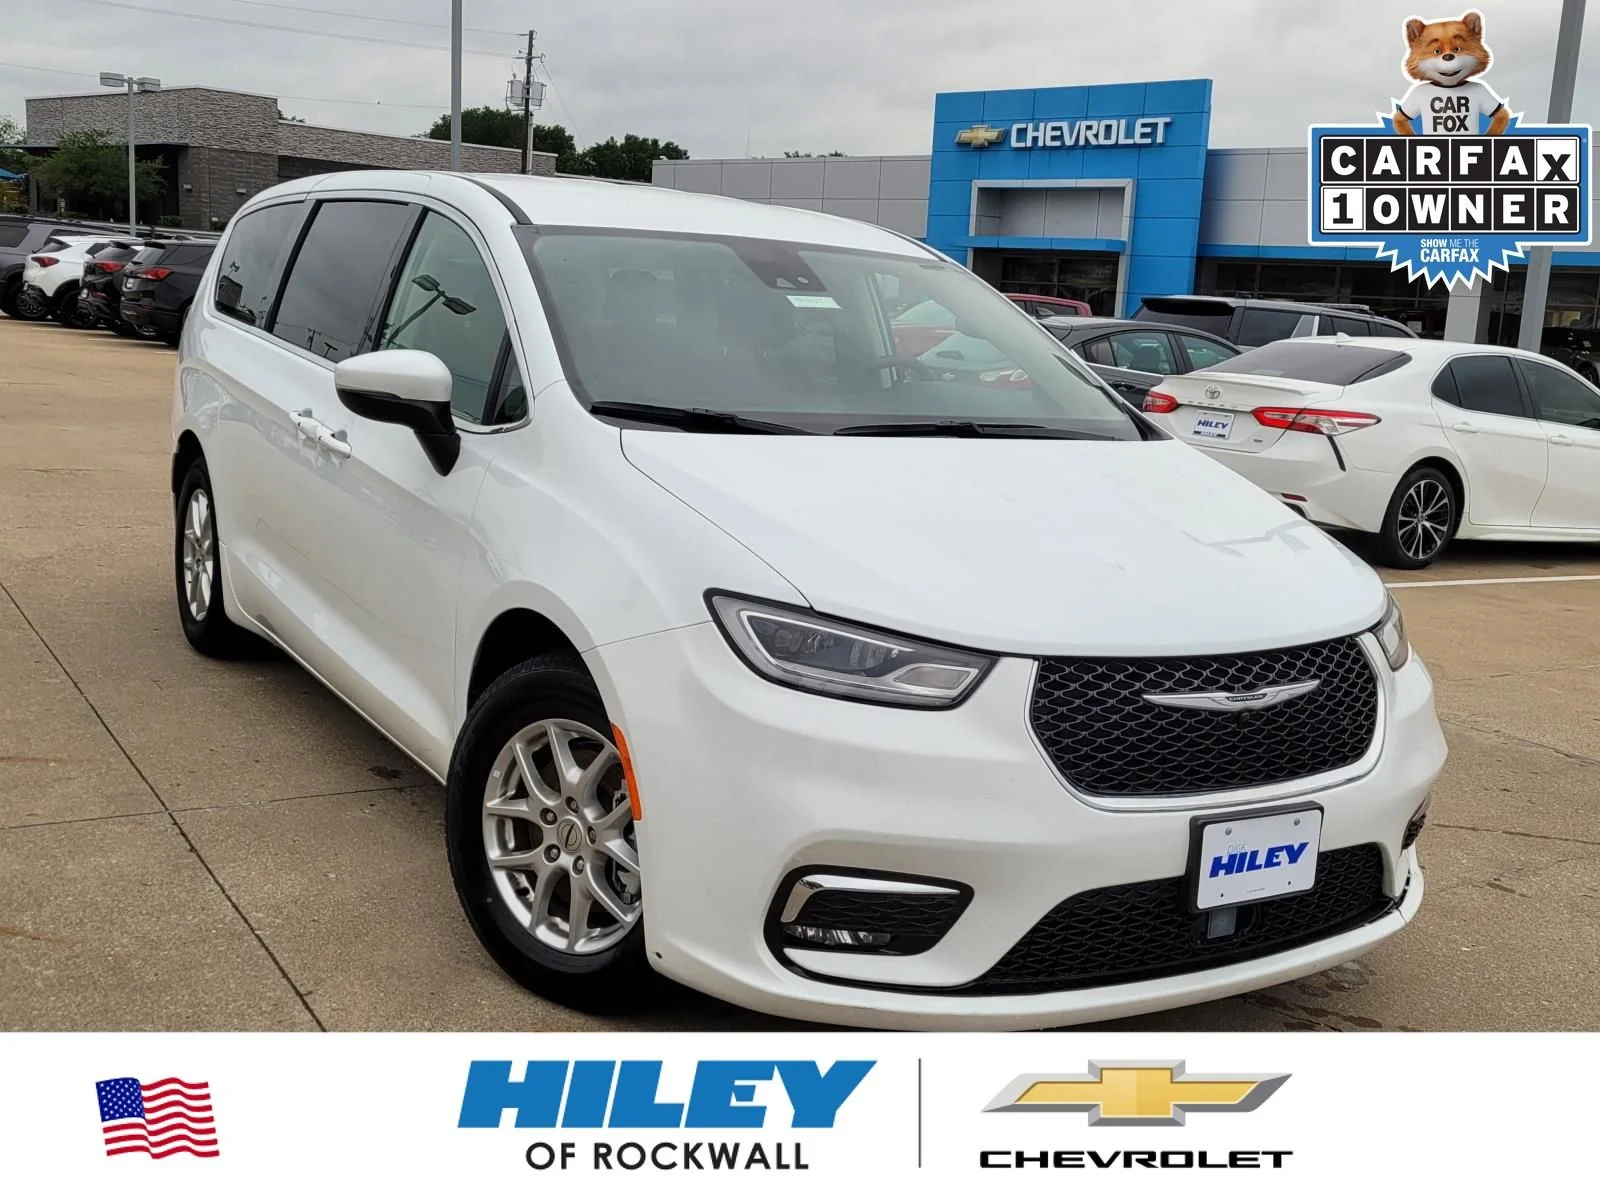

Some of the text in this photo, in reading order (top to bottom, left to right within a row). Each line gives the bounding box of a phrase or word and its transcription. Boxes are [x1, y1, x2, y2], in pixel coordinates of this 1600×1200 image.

[1010, 117, 1171, 148] CHEVROLET
[1197, 420, 1229, 429] HILEY
[1209, 842, 1309, 878] HILEY
